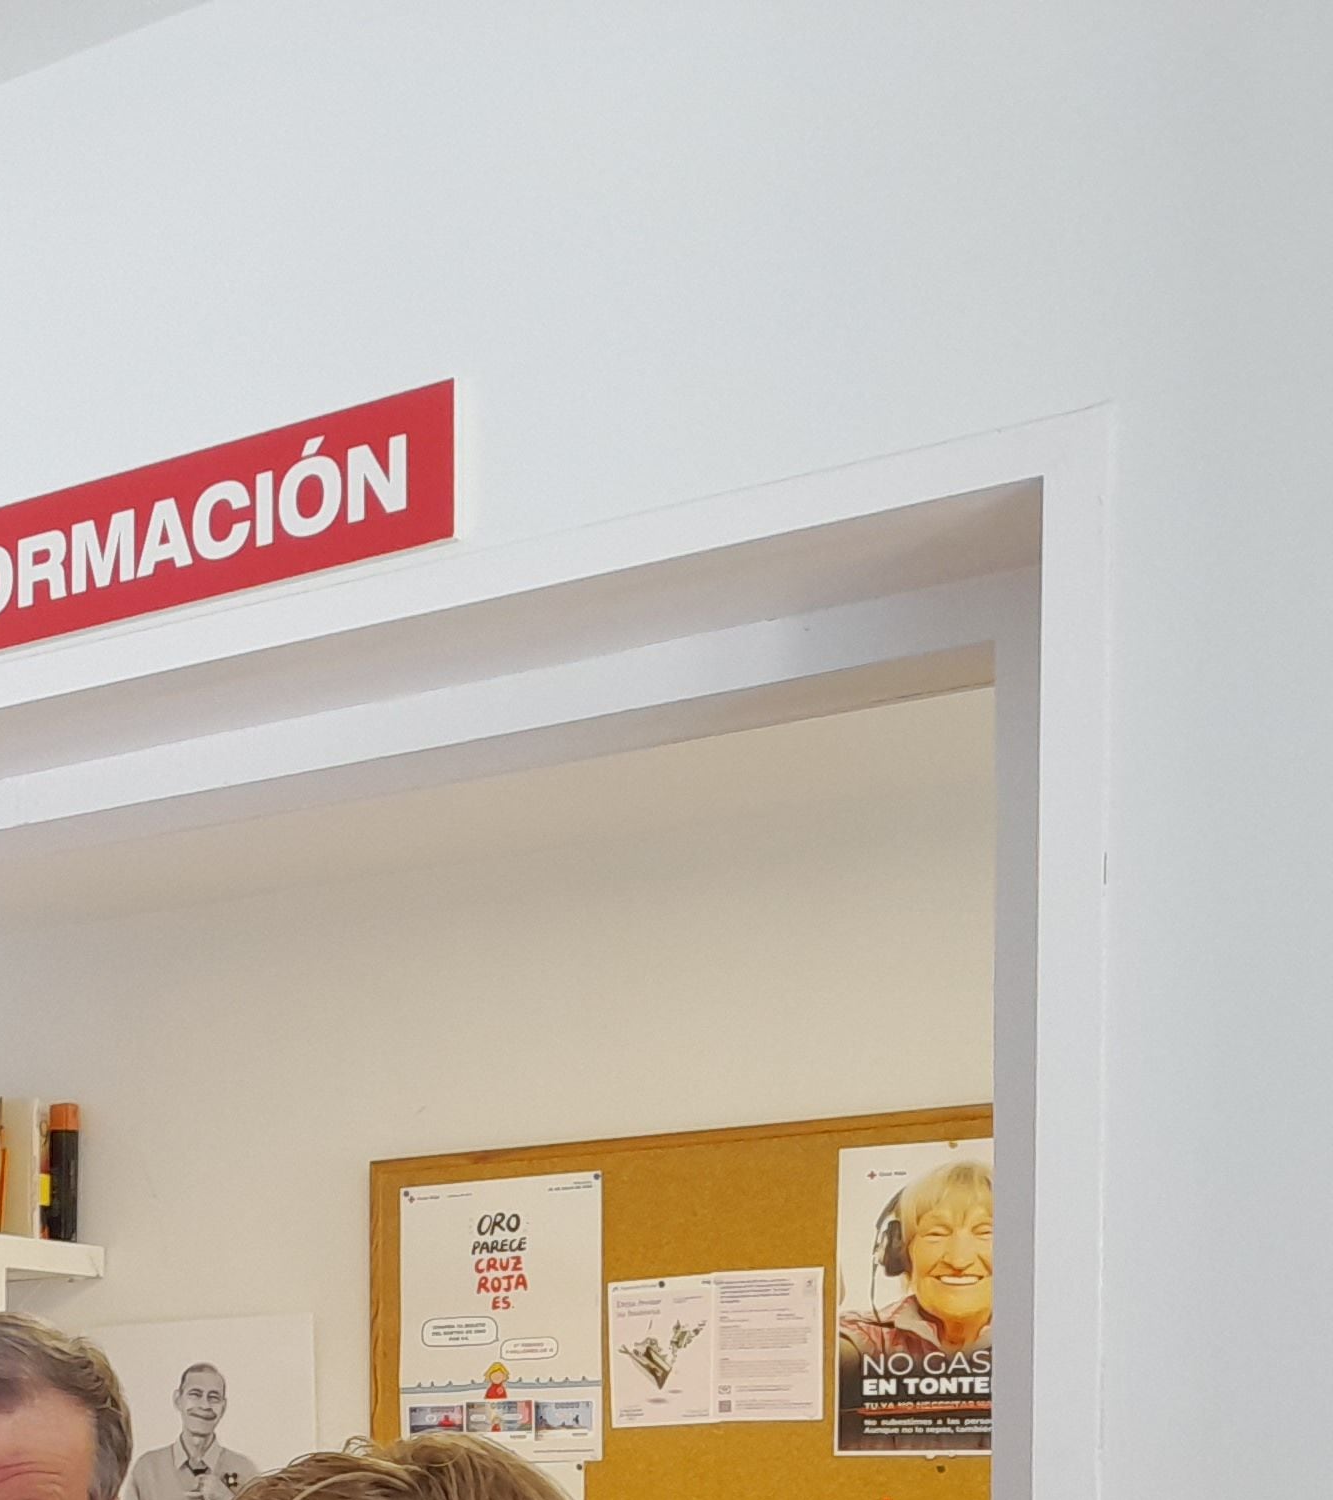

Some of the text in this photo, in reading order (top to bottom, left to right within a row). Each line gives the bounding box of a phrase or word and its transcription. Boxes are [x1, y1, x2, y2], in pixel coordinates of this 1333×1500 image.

[476, 1212, 521, 1236] ORO
[471, 1237, 527, 1255] PARECE
[474, 1255, 523, 1274] CRUZ
[476, 1273, 528, 1294] ROJA
[490, 1296, 515, 1310] ES.
[862, 1350, 991, 1376] NO GAS
[862, 1376, 990, 1396] EN TONTE
